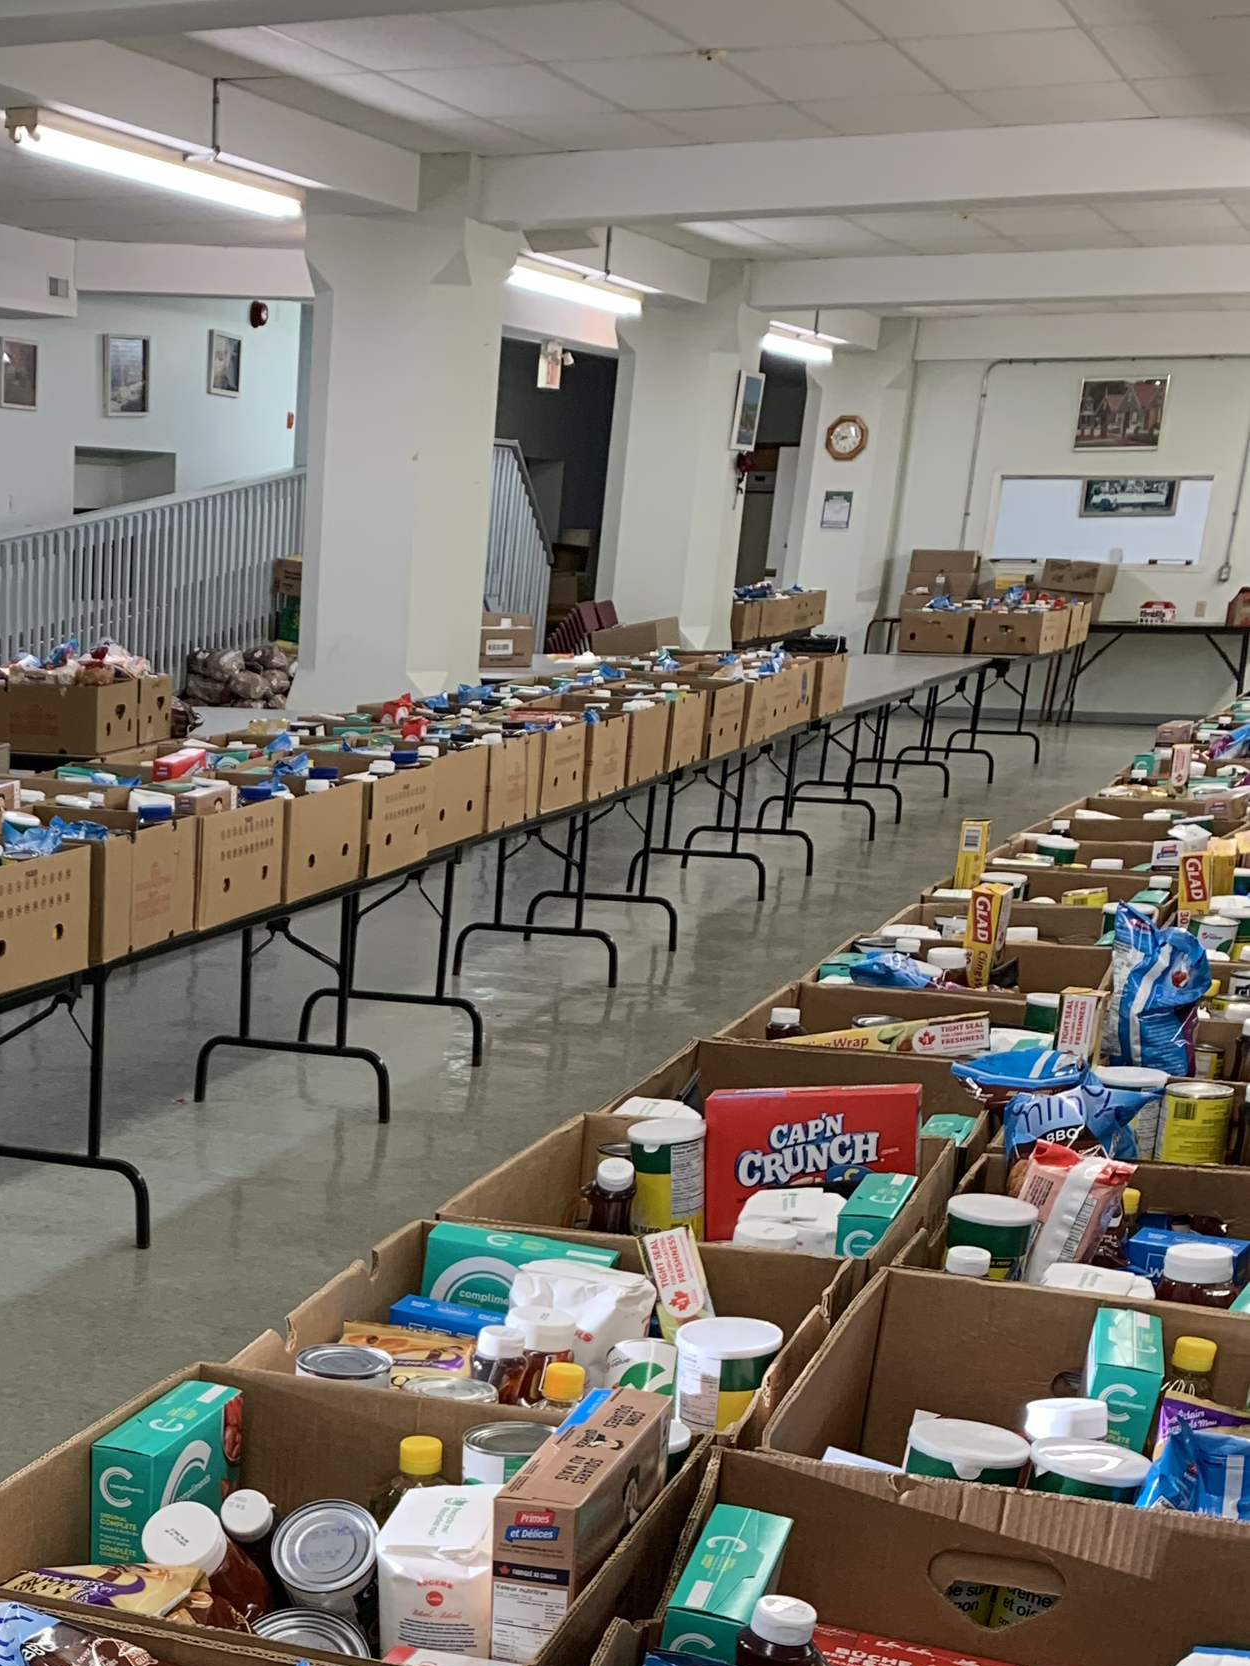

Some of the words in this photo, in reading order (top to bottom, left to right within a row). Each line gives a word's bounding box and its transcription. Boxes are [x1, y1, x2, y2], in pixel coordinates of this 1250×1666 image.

[1185, 858, 1205, 900] GLAD
[975, 896, 991, 942] GLAD
[1063, 1000, 1073, 1024] SEAL
[1074, 1001, 1086, 1045] FRESHNESS
[940, 1023, 964, 1033] TIGHT
[967, 1021, 985, 1031] SEAL
[1061, 1026, 1071, 1048] TIGHT
[941, 1034, 985, 1045] FRESHNESS
[1046, 1129, 1079, 1143] BBQ
[736, 1132, 880, 1187] CRUNCH
[651, 1239, 664, 1261] SEAL
[668, 1234, 686, 1283] FRESHNESS
[657, 1262, 669, 1289] TIGHT
[623, 1410, 645, 1427] CORN
[572, 1457, 604, 1484] SQUARES
[520, 1513, 550, 1524] Primes
[510, 1529, 519, 1538] et
[522, 1528, 553, 1540] Délices
[495, 1583, 517, 1593] Valeur
[519, 1587, 549, 1597] nutritive
